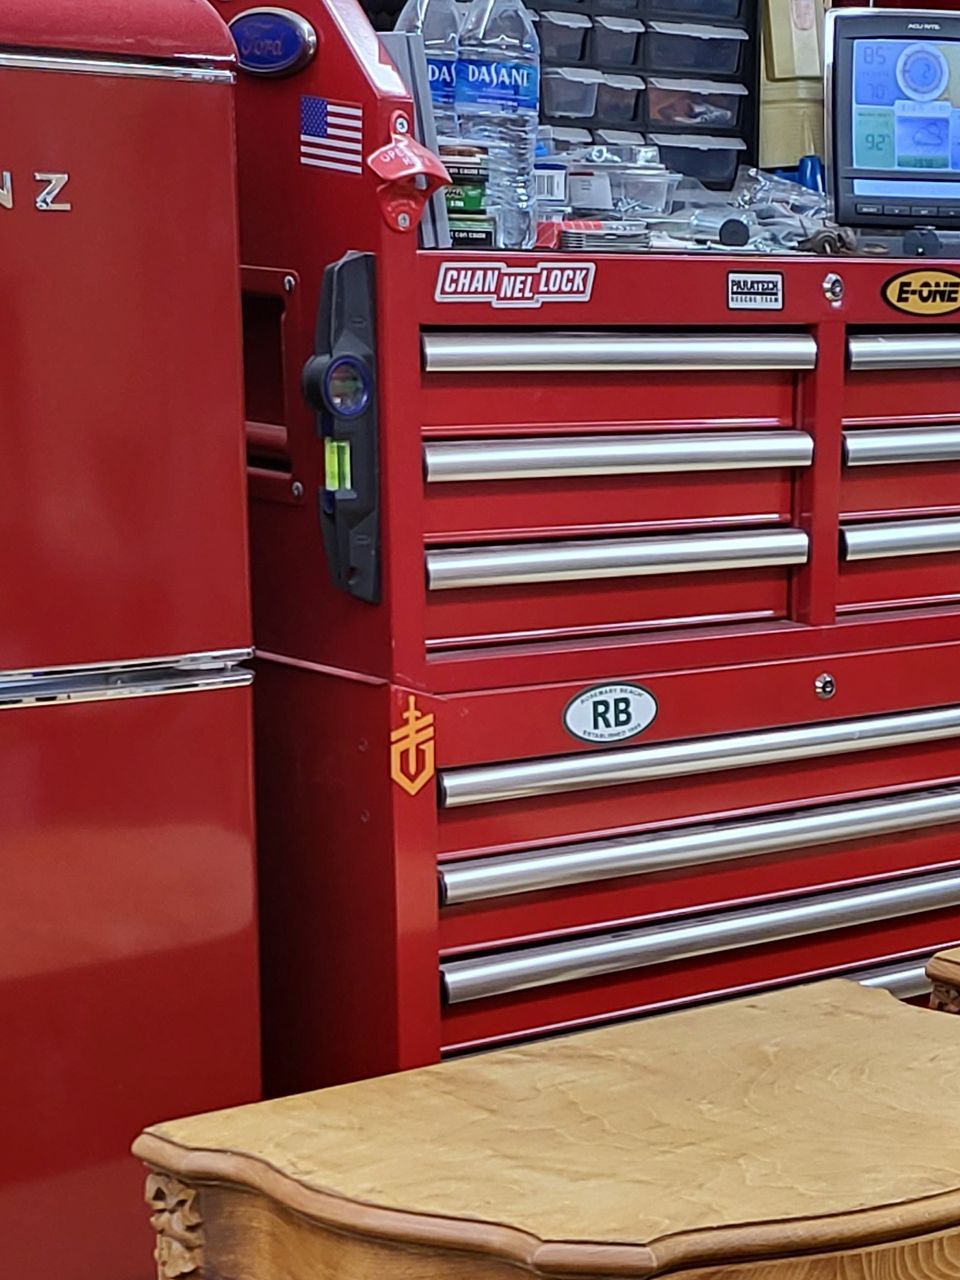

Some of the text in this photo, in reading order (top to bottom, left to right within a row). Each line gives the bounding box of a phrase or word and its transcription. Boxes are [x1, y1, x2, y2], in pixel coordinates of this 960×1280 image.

[428, 63, 456, 87] DAS
[468, 62, 529, 88] DASANI
[897, 281, 960, 303] E-ONE
[593, 697, 632, 730] RB
